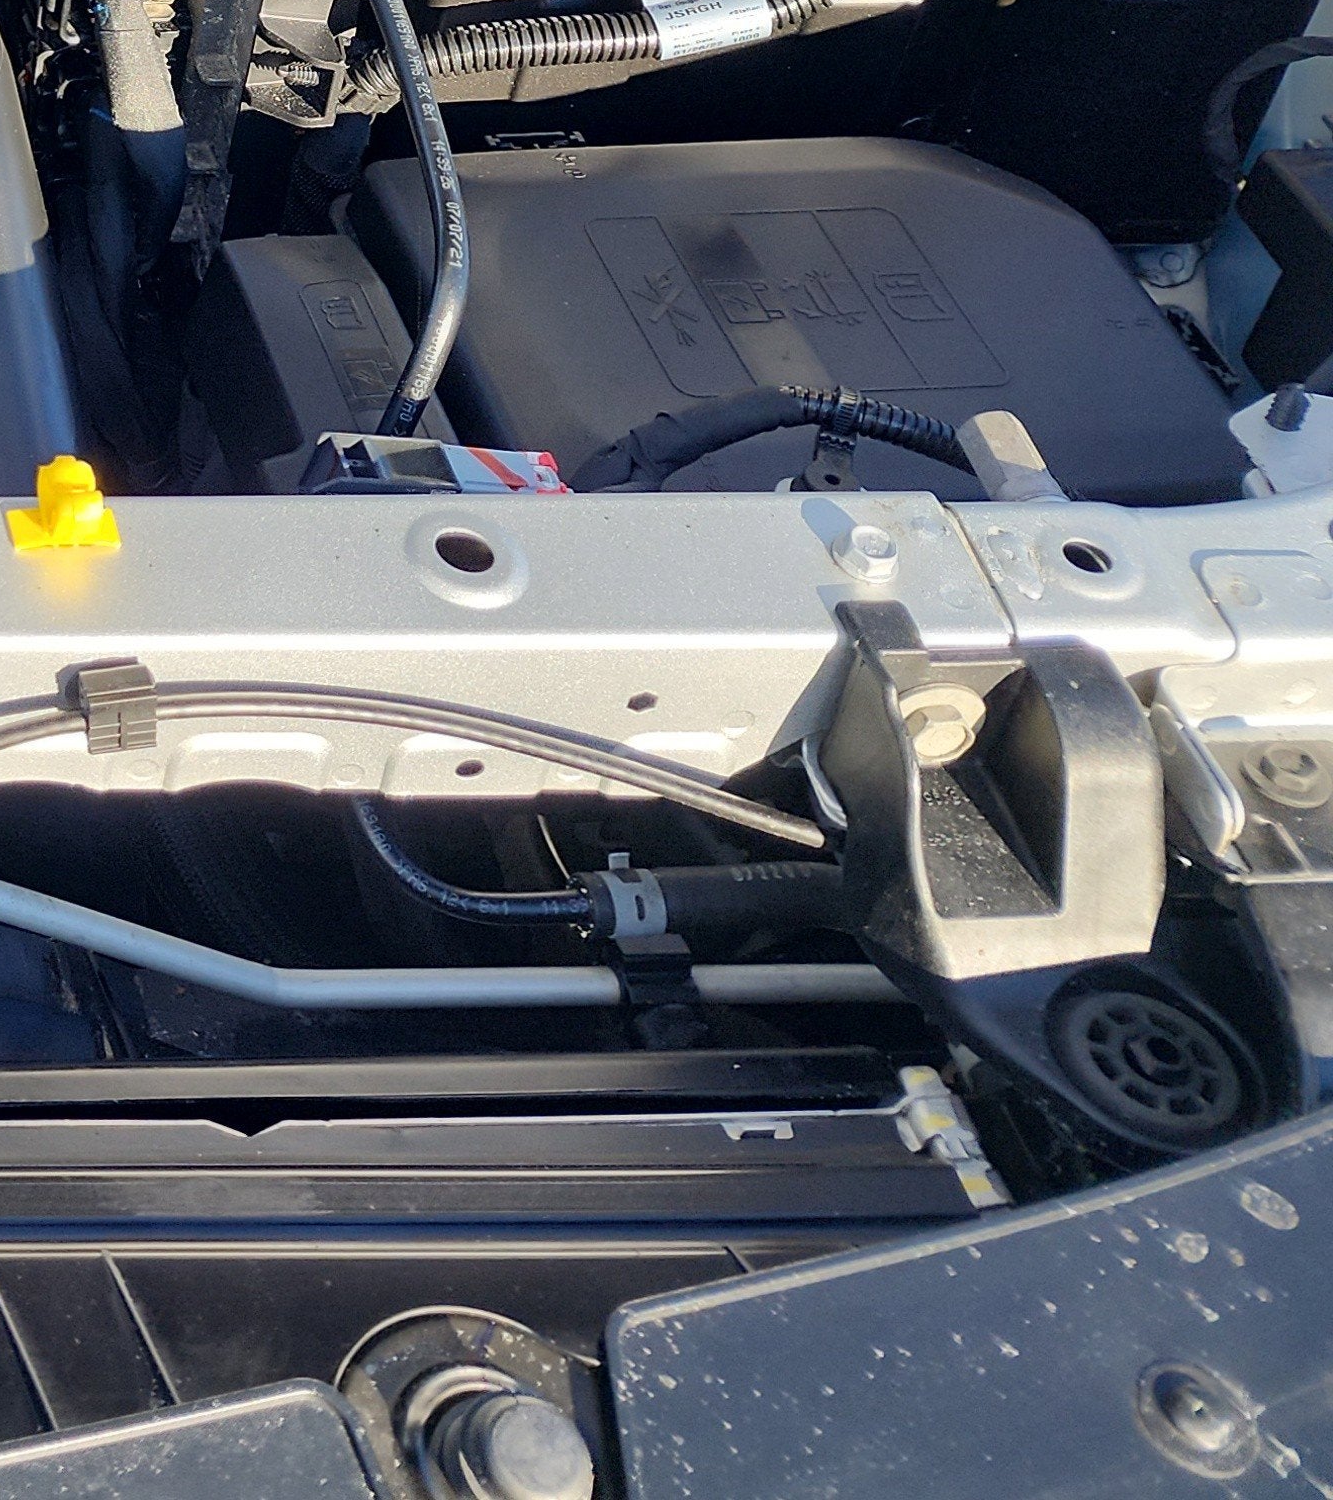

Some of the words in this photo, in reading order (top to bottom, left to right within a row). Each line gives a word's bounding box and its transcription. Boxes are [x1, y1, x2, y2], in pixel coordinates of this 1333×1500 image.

[665, 1, 723, 21] JSRGH
[431, 139, 457, 194] 14:39:26
[445, 201, 464, 268] 07/07/21
